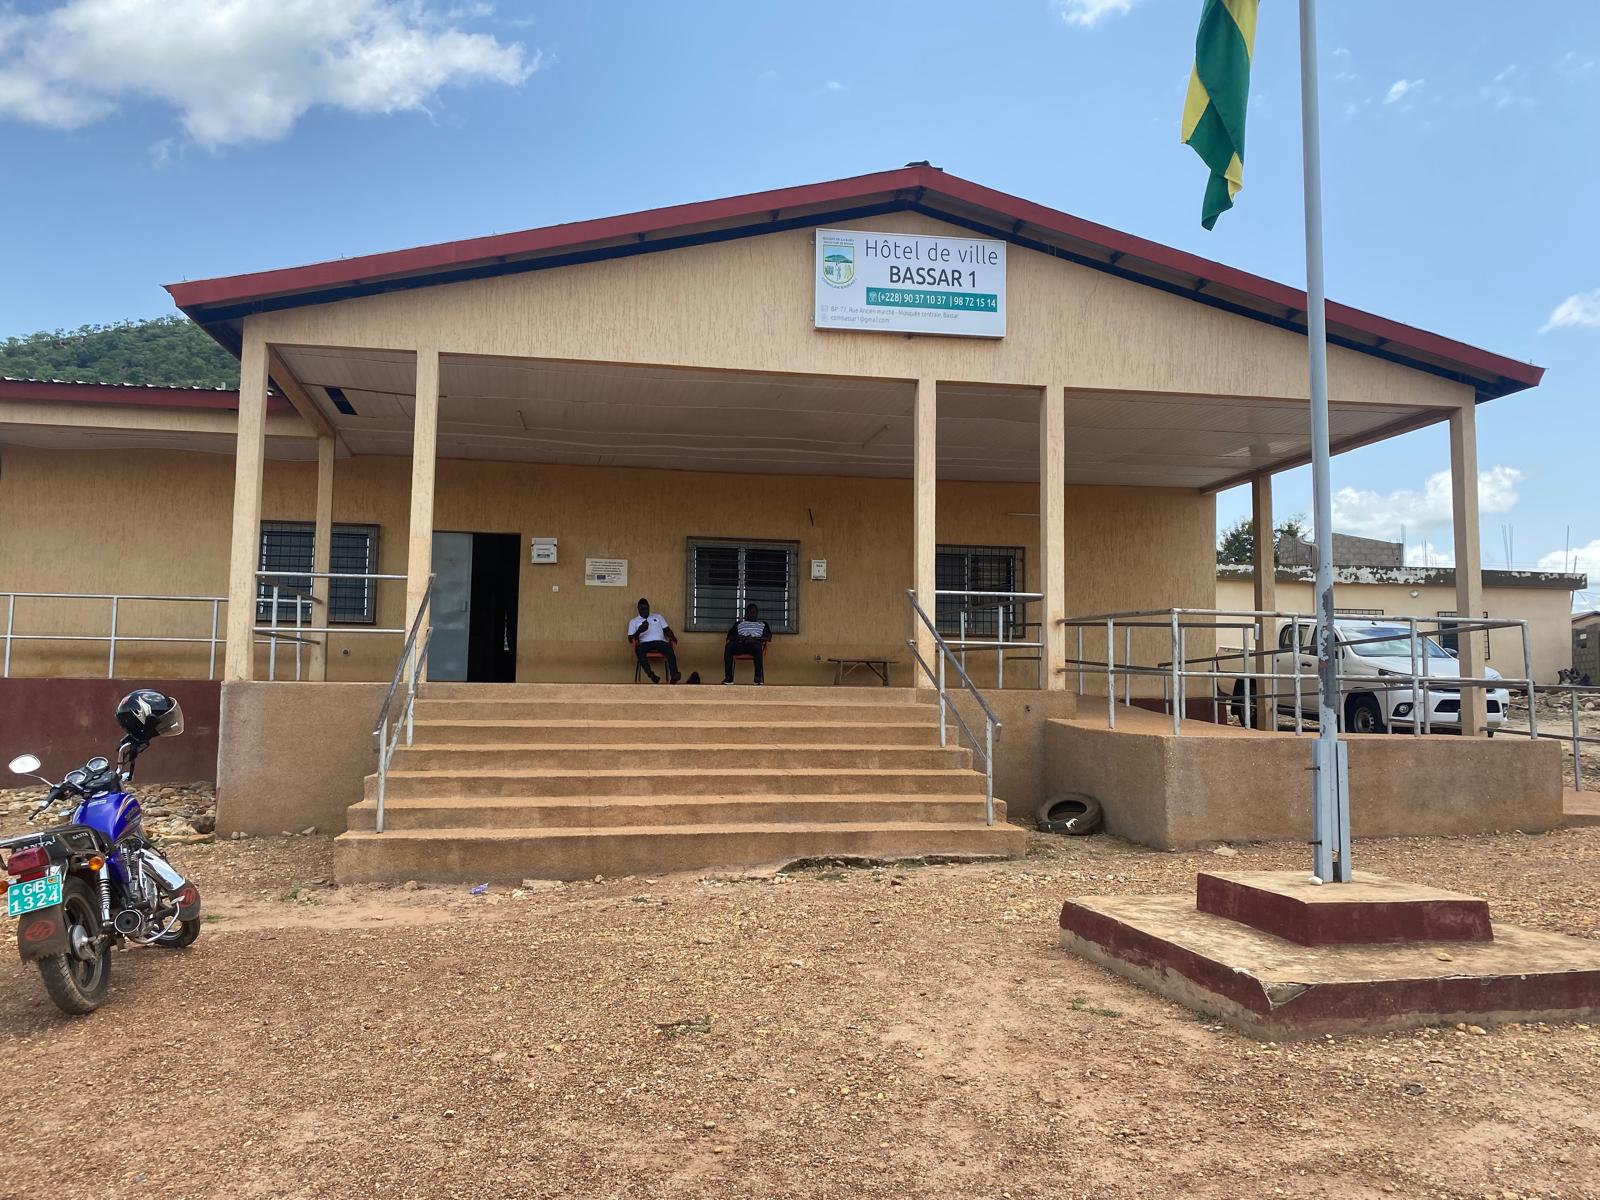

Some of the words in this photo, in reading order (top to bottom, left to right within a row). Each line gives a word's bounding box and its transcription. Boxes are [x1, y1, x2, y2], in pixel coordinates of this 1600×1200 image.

[865, 239, 919, 260] Hôtel
[927, 242, 951, 262] de
[958, 245, 998, 265] ville
[889, 265, 962, 287] BASSAR
[969, 270, 976, 288] 1
[877, 292, 902, 303] (+228)
[903, 294, 913, 303] 90
[914, 294, 924, 304] 37
[926, 295, 936, 304] 10
[937, 295, 946, 305] 37
[953, 296, 963, 306] 98
[964, 297, 974, 307] 72
[976, 298, 985, 307] 15
[986, 299, 996, 308] 14
[11, 890, 58, 913] 1324
